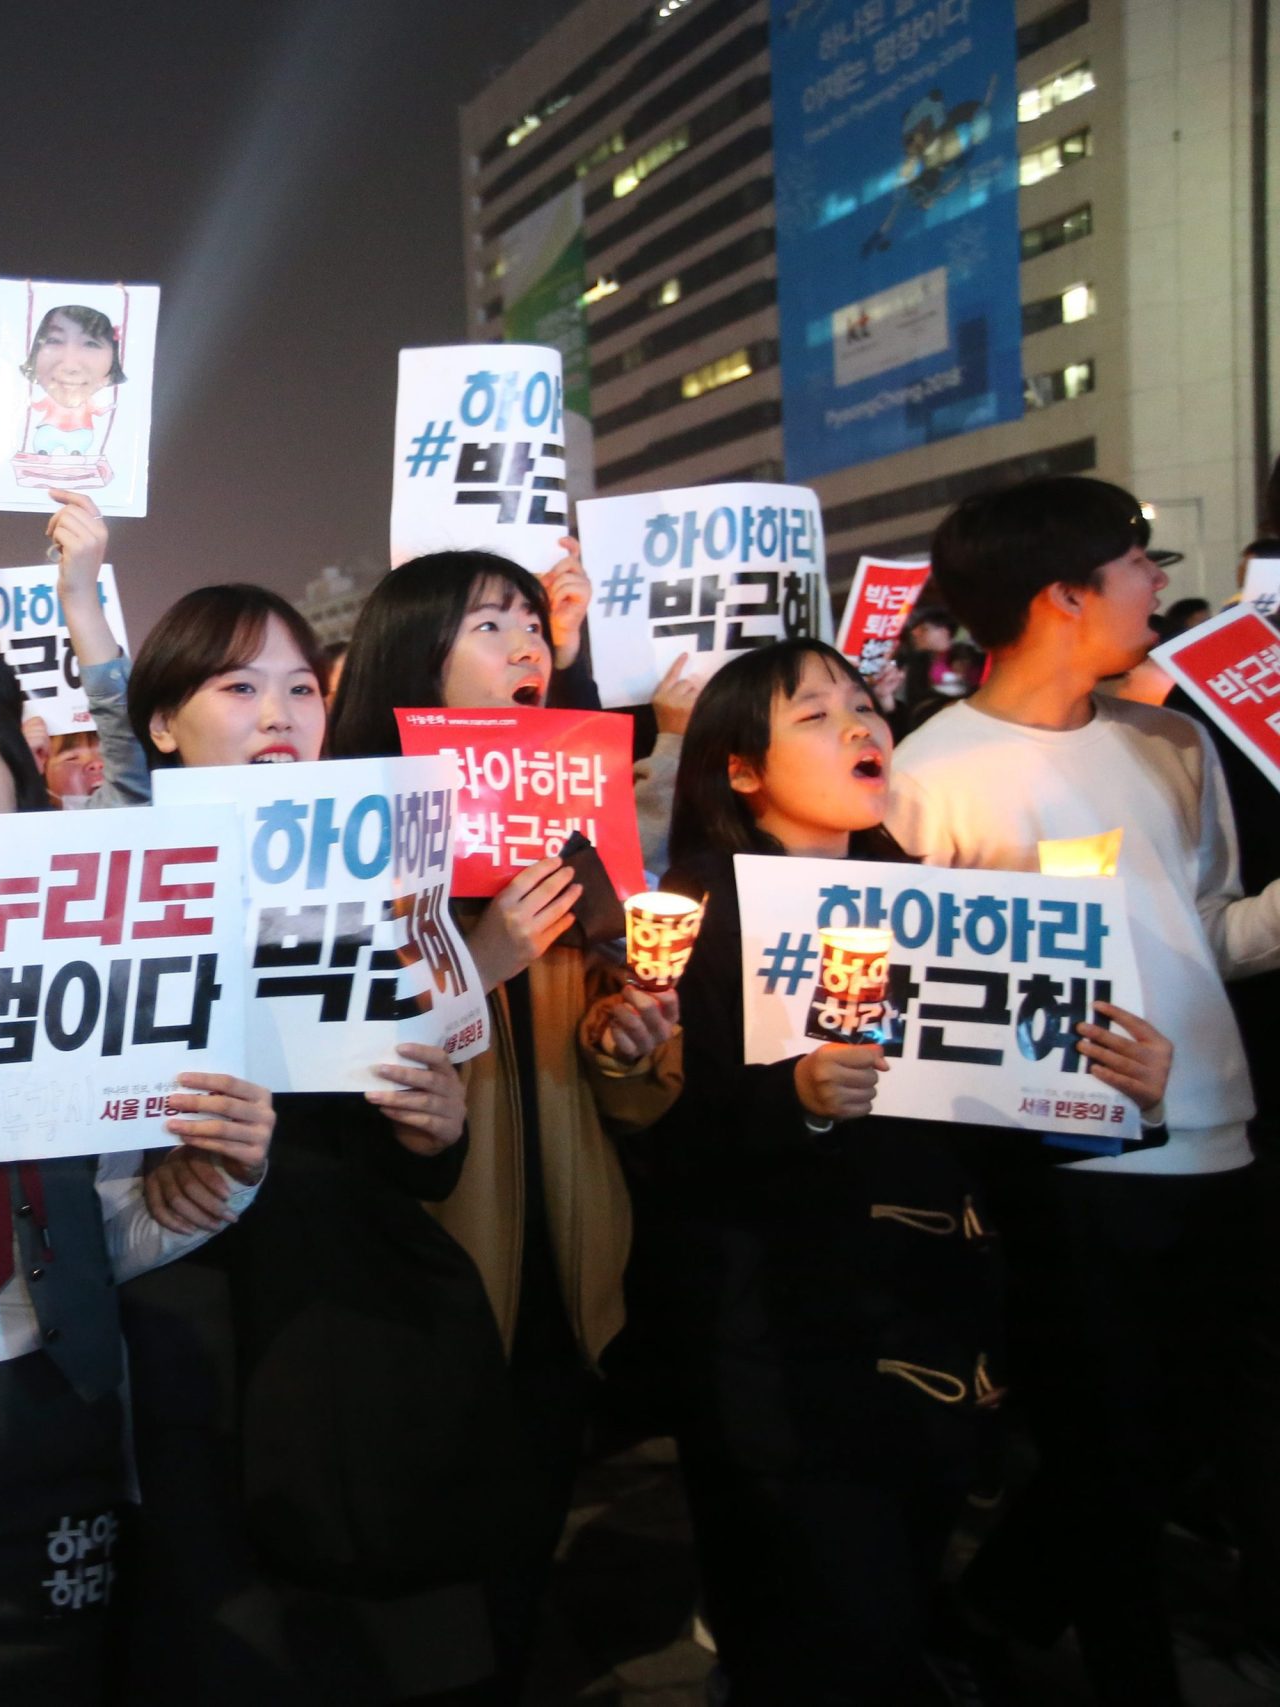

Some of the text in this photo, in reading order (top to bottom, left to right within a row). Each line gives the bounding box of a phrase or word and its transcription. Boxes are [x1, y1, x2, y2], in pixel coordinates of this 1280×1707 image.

[643, 505, 817, 569] 하야하라
[251, 789, 452, 890] 하야하라
[252, 884, 468, 1023] 박근혜
[817, 884, 1110, 969] 하야하라
[100, 1098, 140, 1121] 서울
[1055, 1099, 1107, 1121] 민중의
[1110, 1104, 1125, 1123] 꿈
